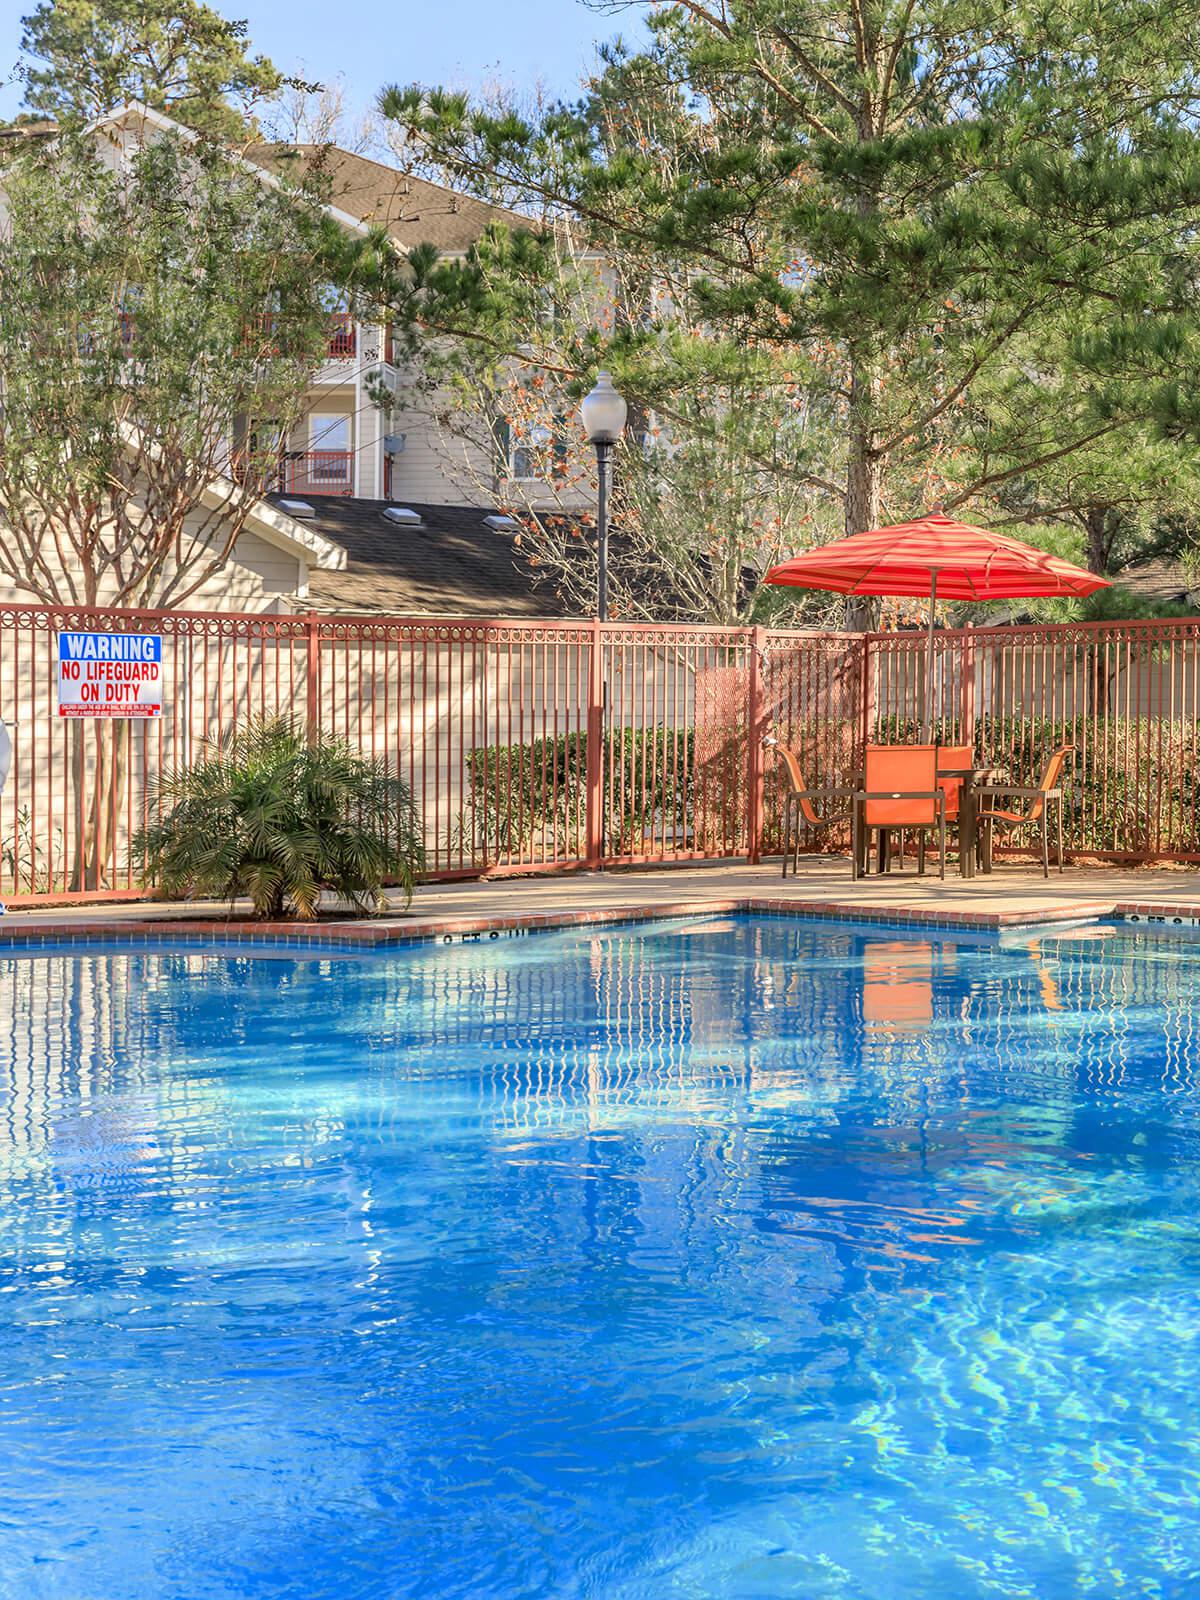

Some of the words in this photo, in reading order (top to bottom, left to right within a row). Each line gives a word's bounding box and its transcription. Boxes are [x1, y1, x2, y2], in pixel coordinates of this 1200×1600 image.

[67, 635, 155, 660] WARNING
[61, 661, 80, 680] NO
[86, 661, 159, 681] LIFEGUARD
[80, 682, 99, 702] ON
[105, 682, 141, 702] DUTY
